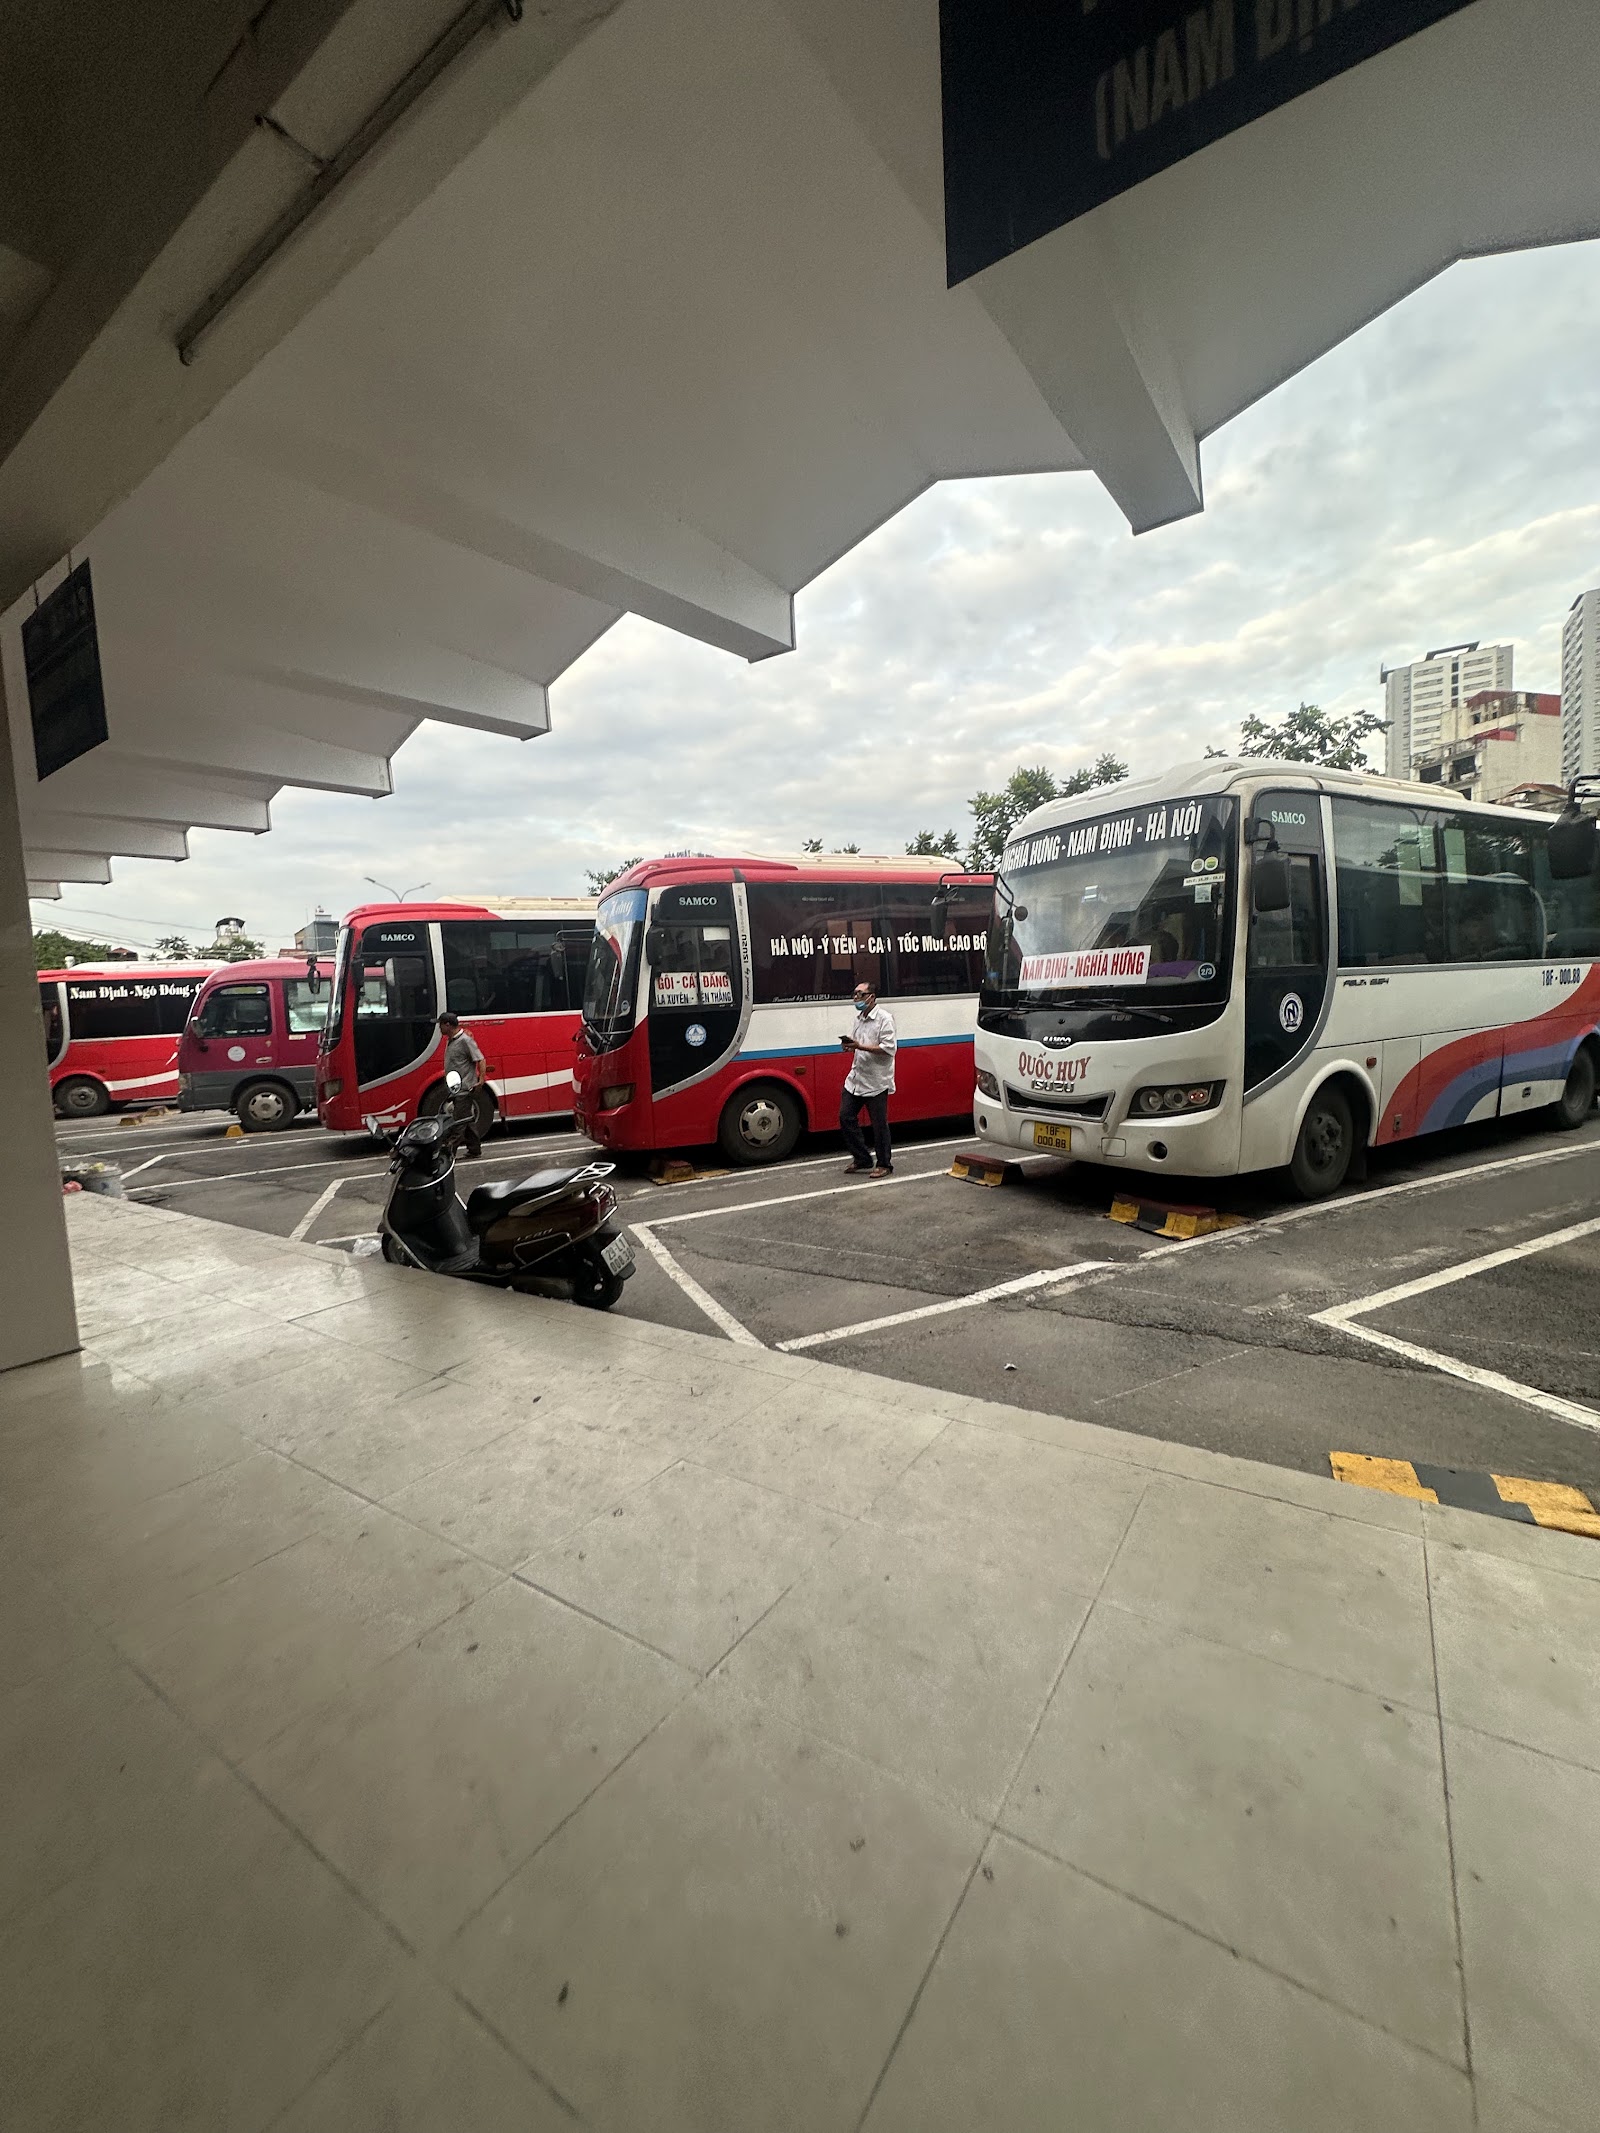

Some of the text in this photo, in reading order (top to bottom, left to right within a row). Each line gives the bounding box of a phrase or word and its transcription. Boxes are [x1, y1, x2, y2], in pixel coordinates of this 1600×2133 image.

[1271, 810, 1306, 825] SAMCO
[1067, 825, 1099, 857] NAM
[1100, 817, 1135, 854] ĐỊNH
[1145, 805, 1167, 842] HÀ
[1170, 800, 1203, 841] NỘI
[678, 896, 717, 906] SAMCO
[380, 933, 415, 942] SAMCO
[770, 934, 789, 956] HÀ
[791, 934, 814, 959] NỘI
[832, 934, 857, 954] YÊN
[897, 931, 920, 953] TỐC
[949, 934, 971, 951] CAO
[741, 934, 749, 964] ISUZU
[1022, 958, 1043, 981] NAM
[1043, 956, 1068, 983] ĐỊNH
[1075, 950, 1108, 978] NGHĨA
[1110, 950, 1145, 976] HƯNG
[657, 974, 675, 990] GÔI
[682, 973, 697, 989] CÁ
[1541, 969, 1554, 986] 18F
[1559, 968, 1580, 985] 000.88
[70, 987, 97, 999] Nam
[99, 986, 128, 1001] Định
[657, 993, 665, 1005] LA
[804, 993, 830, 1002] ISUZU
[1018, 1051, 1091, 1081] QUỐC HUY
[1031, 1079, 1075, 1093] ISUZU
[1045, 1125, 1060, 1136] 18F
[1037, 1135, 1066, 1149] 000.88
